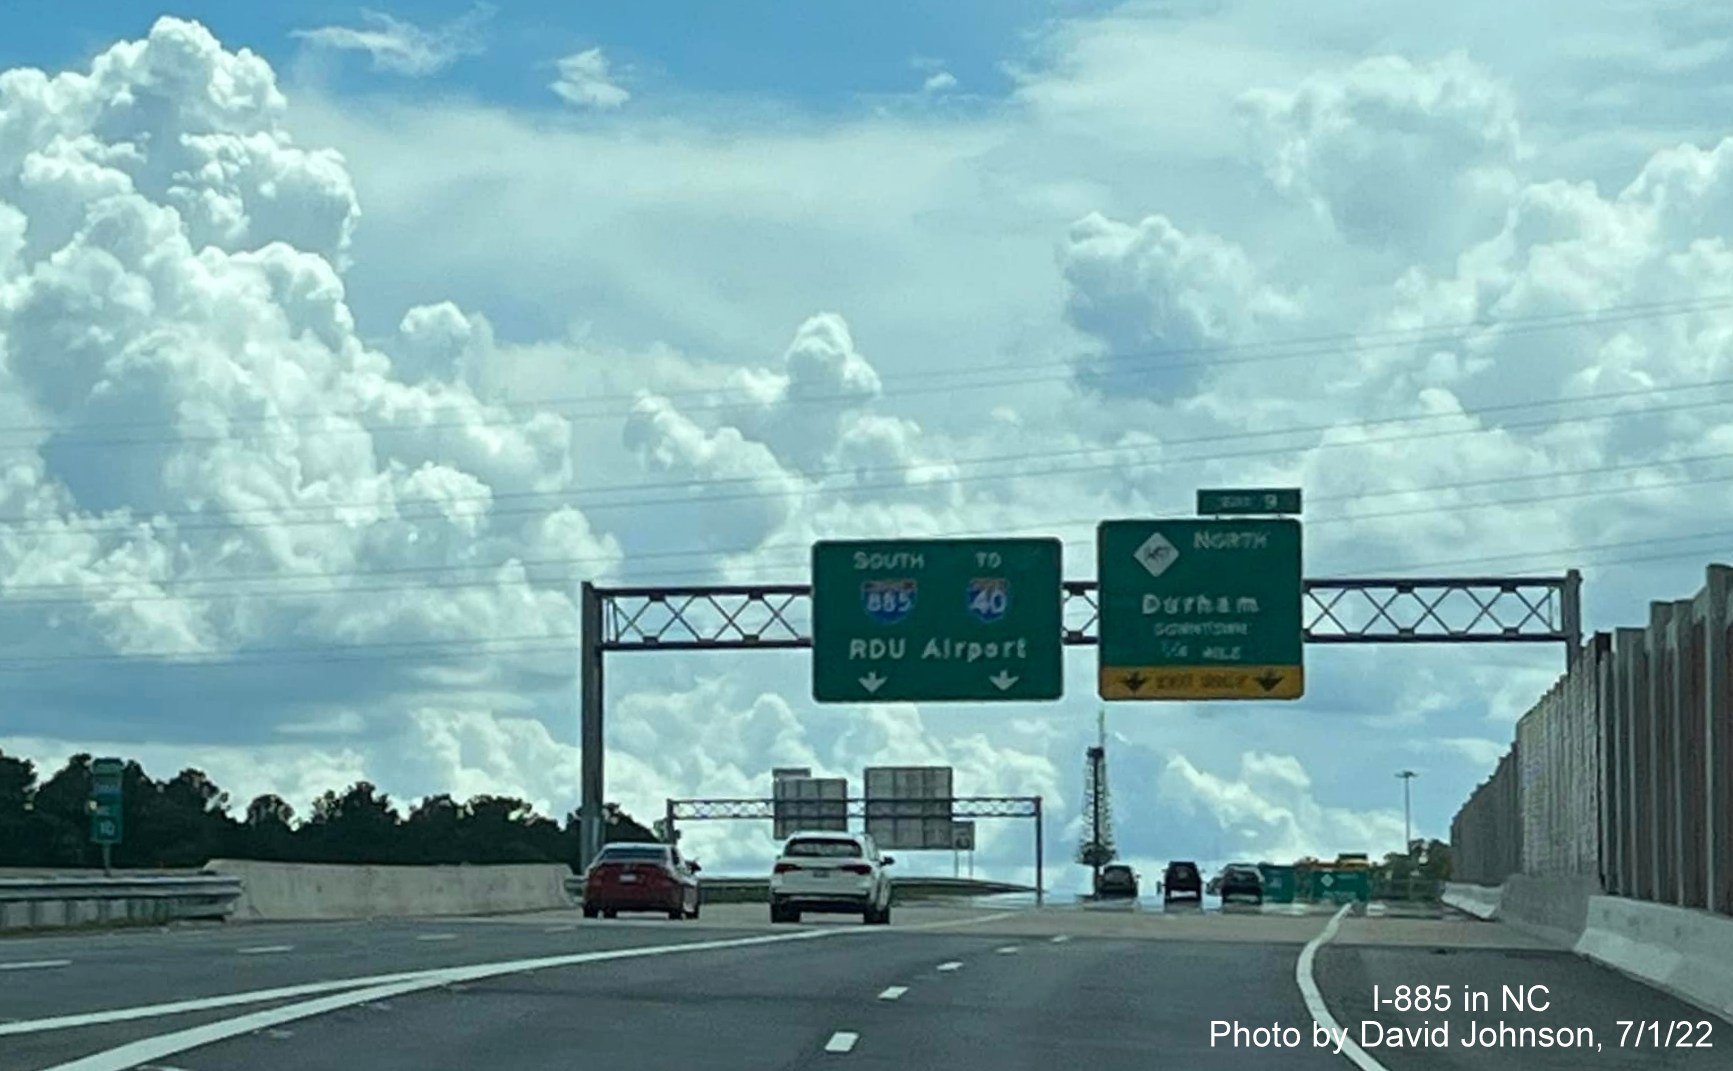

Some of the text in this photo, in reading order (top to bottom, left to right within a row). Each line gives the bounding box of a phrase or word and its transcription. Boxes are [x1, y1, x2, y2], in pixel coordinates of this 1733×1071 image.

[1193, 531, 1269, 550] NORTH
[853, 551, 925, 570] SOUTH
[975, 552, 1002, 569] TO
[866, 591, 912, 613] 885
[973, 590, 1008, 614] 40
[1141, 593, 1259, 615] Durham
[849, 637, 1028, 663] RDU Airport
